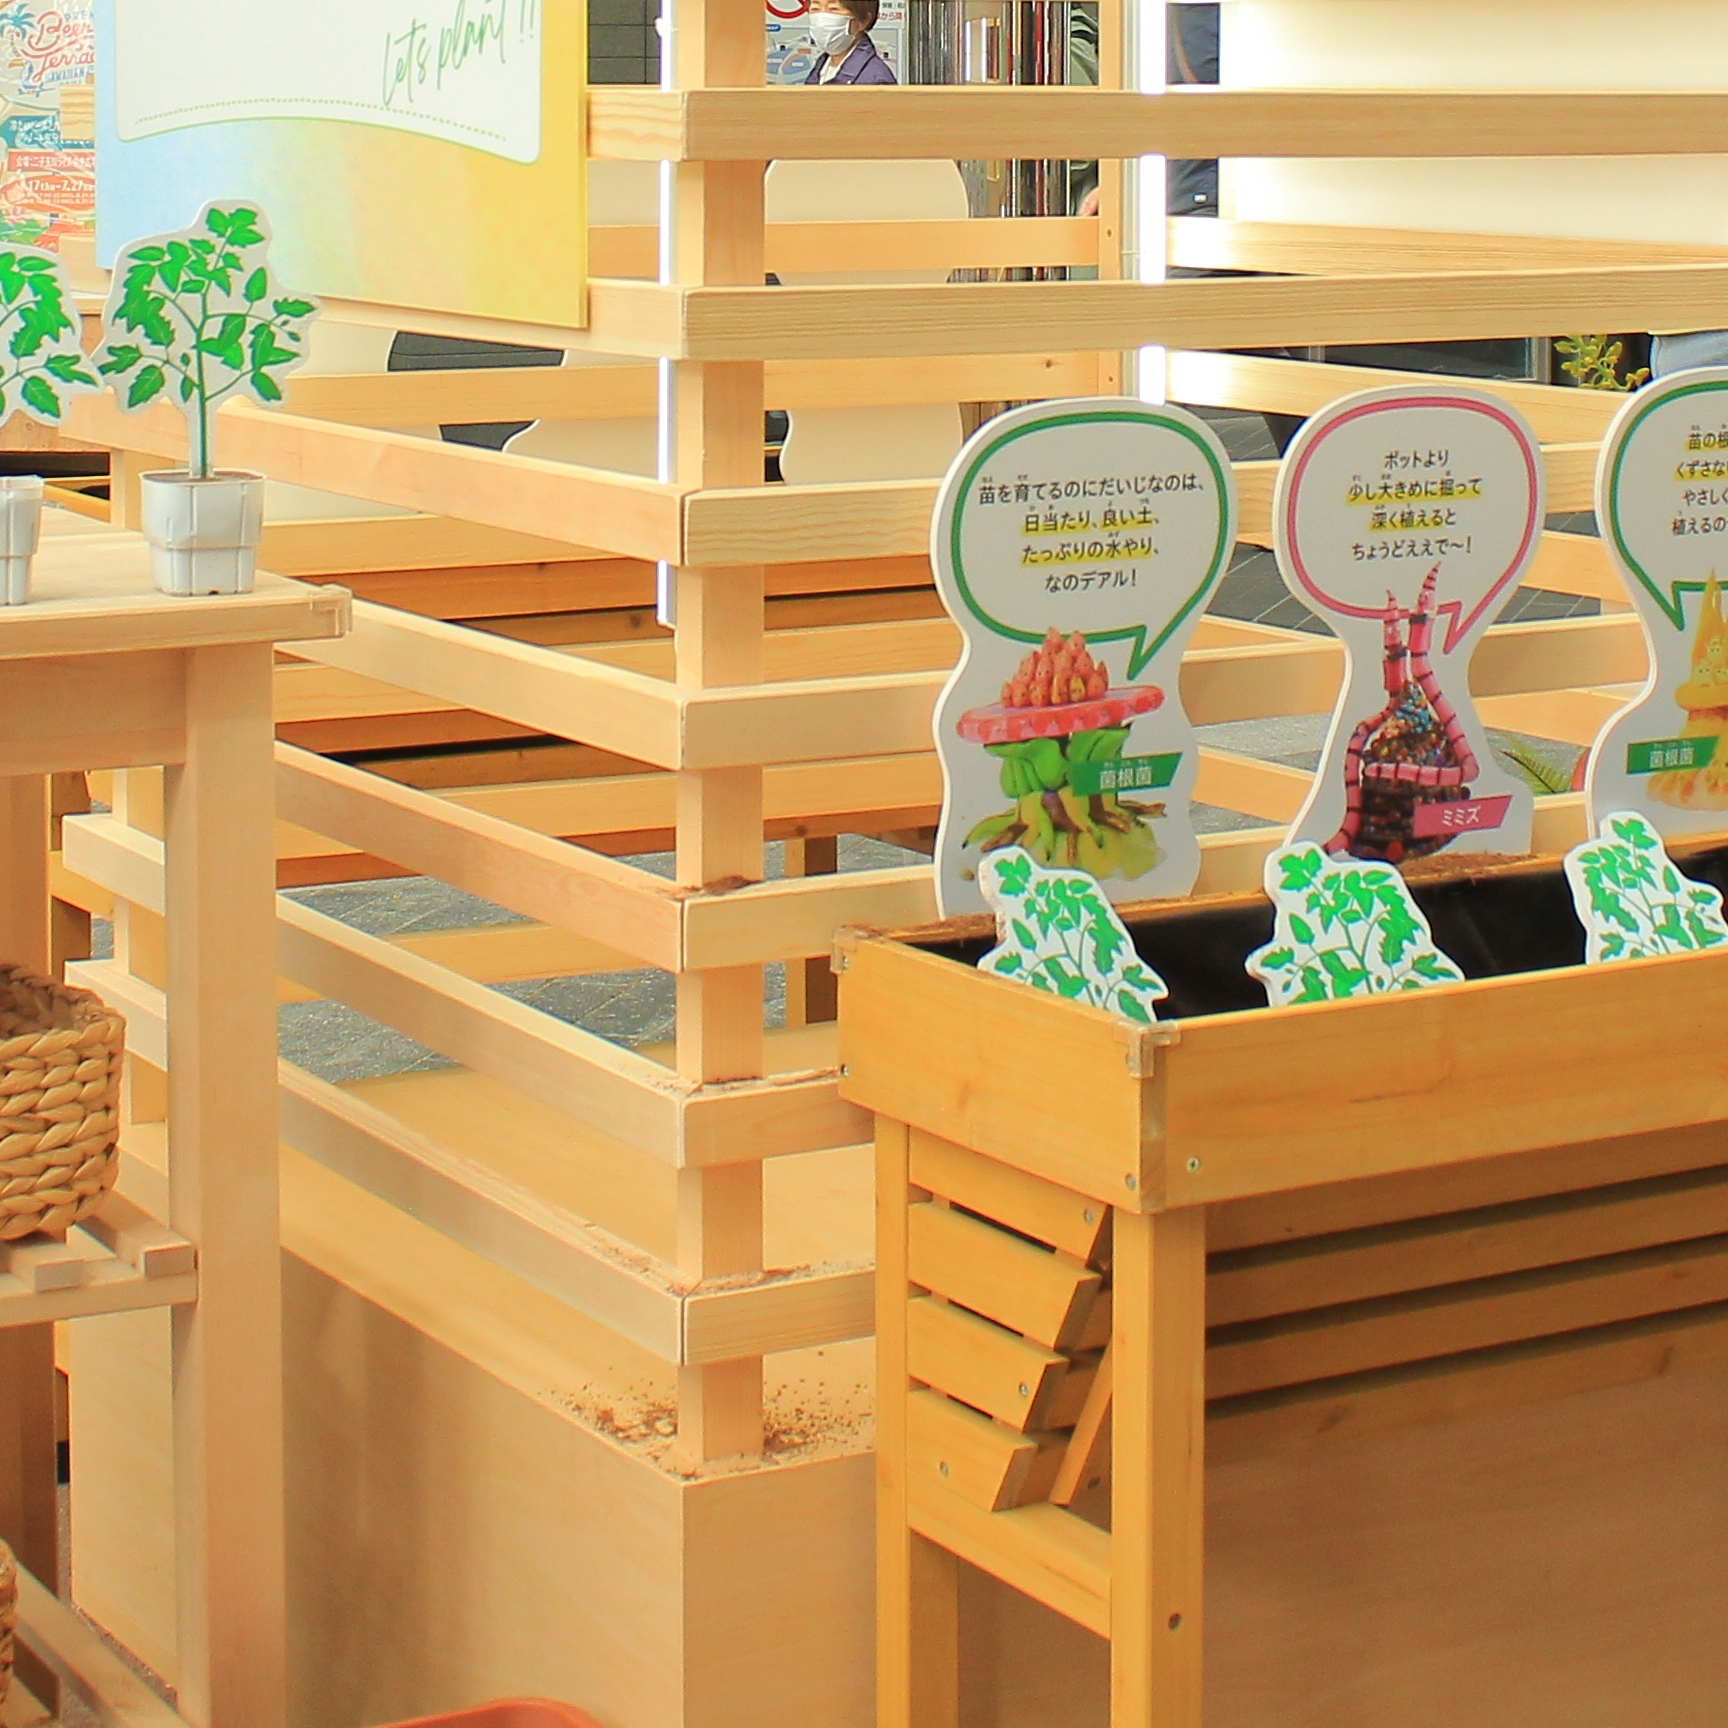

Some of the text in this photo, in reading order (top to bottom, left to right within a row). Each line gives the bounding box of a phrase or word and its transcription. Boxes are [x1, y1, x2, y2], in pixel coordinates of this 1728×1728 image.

[1383, 449, 1450, 470] ポットより
[978, 473, 1205, 506] 苗を育てるのにだいじなのは、
[1348, 477, 1483, 503] 少し大きめに掘って
[1024, 507, 1160, 533] 日当たり、良い土、
[1371, 508, 1457, 530] 深く植えると
[1022, 537, 1160, 564] たっぷりの水やり、
[1045, 568, 1137, 593] なのデアル！
[1098, 766, 1154, 789] 菌根菌
[1441, 806, 1482, 827] ミミズ
